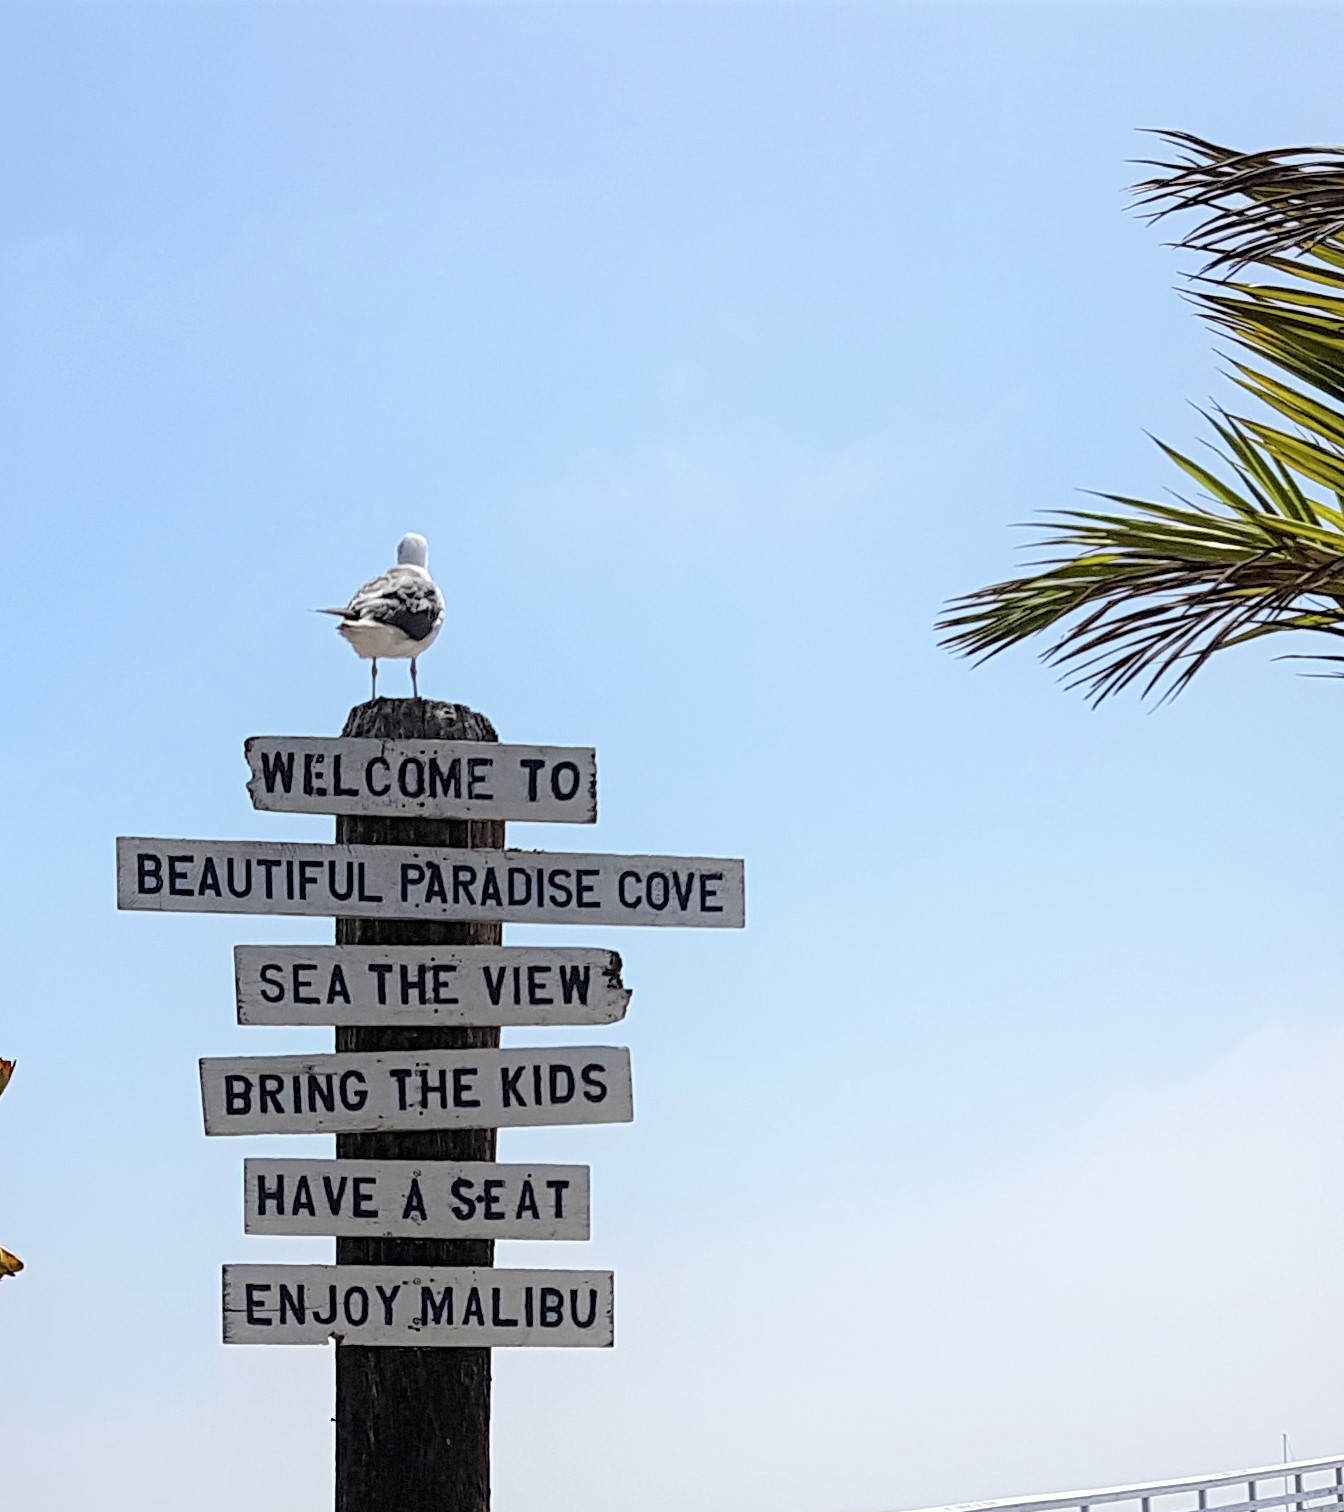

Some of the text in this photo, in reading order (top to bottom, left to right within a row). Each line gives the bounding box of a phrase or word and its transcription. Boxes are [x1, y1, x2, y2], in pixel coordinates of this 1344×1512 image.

[261, 752, 580, 802] WELCOME TO
[136, 854, 724, 912] BEAUTIFUL PARADISE COVE
[260, 964, 590, 1005] SEA THE VIEW
[224, 1064, 608, 1115] BRING THE KIDS
[257, 1175, 570, 1220] HAVE A SEAT
[245, 1283, 597, 1329] ENJOY MALIBU
